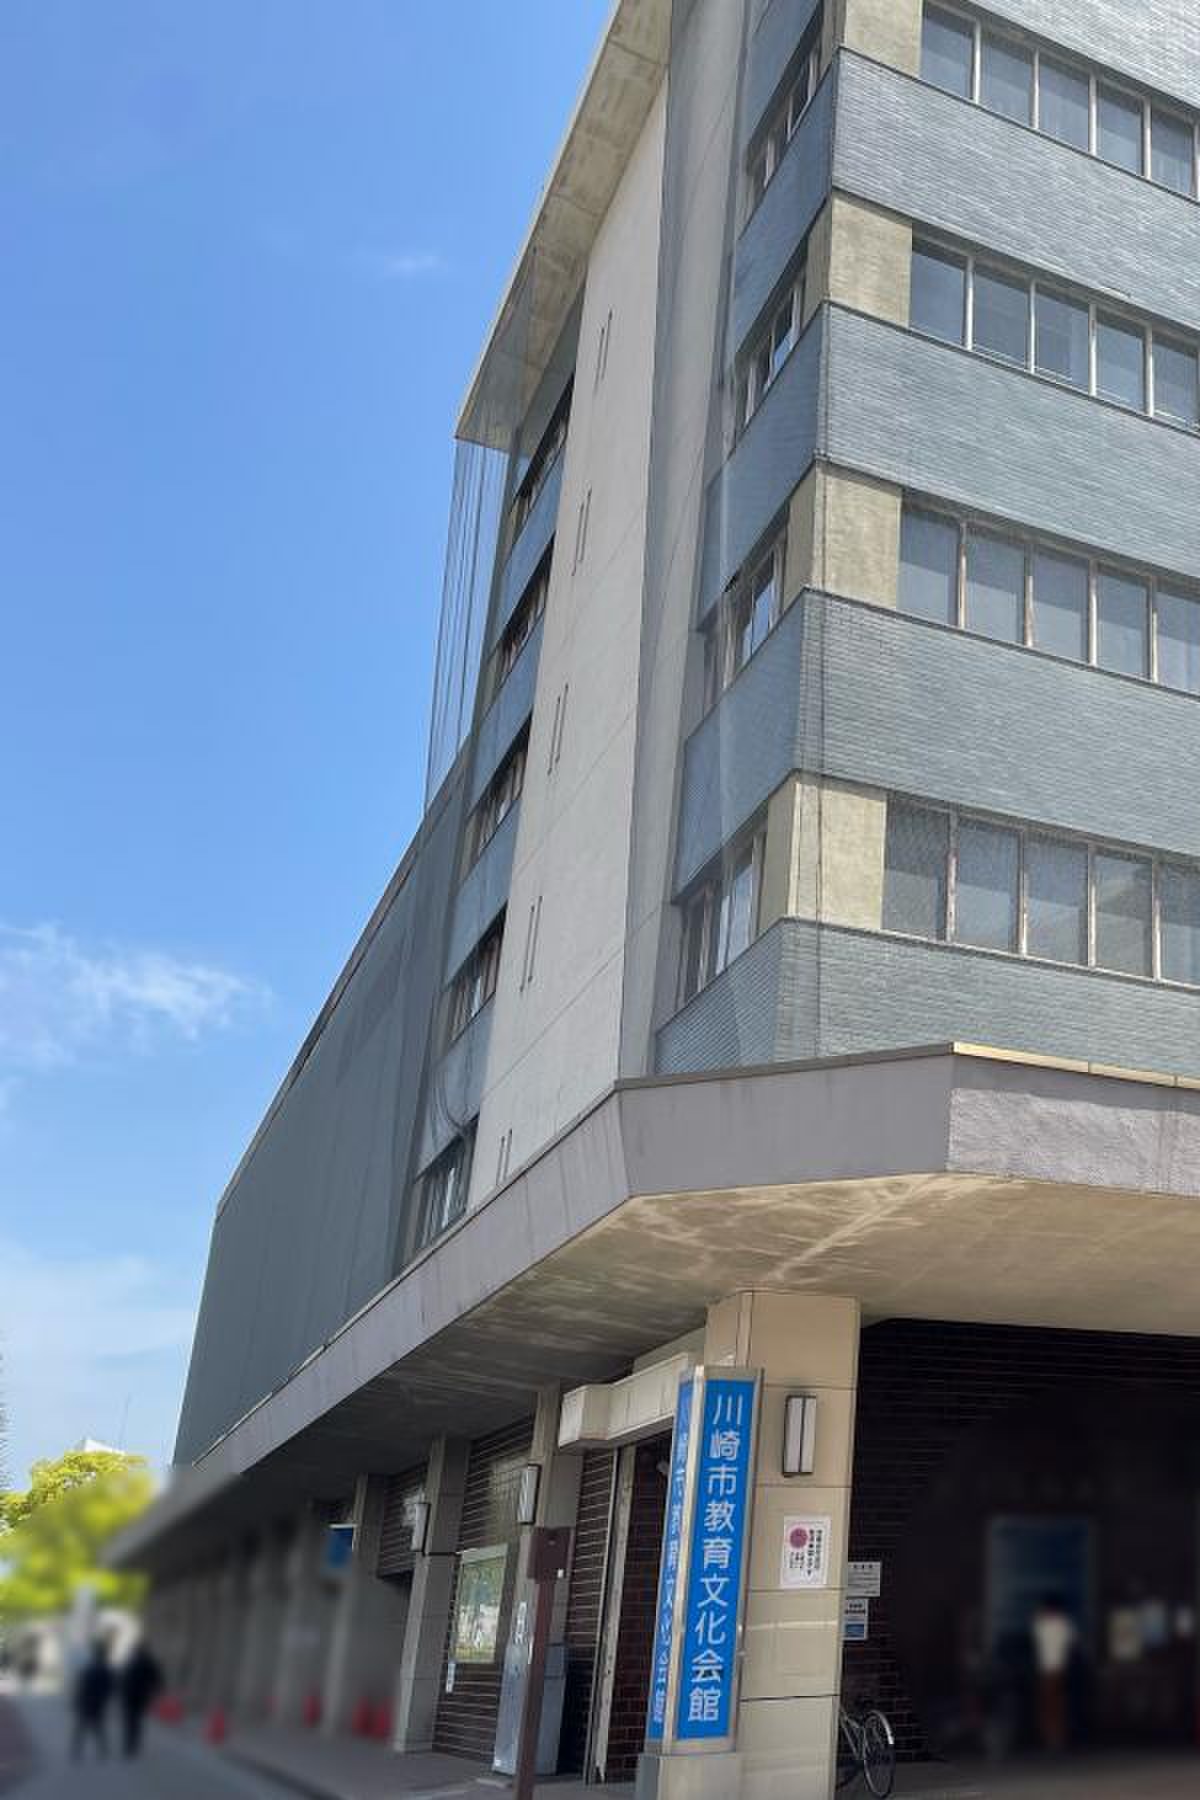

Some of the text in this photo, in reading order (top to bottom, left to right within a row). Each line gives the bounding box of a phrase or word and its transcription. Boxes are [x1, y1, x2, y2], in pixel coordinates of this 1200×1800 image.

[652, 1398, 689, 1723] 市教育文化会館
[687, 1394, 744, 1722] 川崎市教育文化会館
